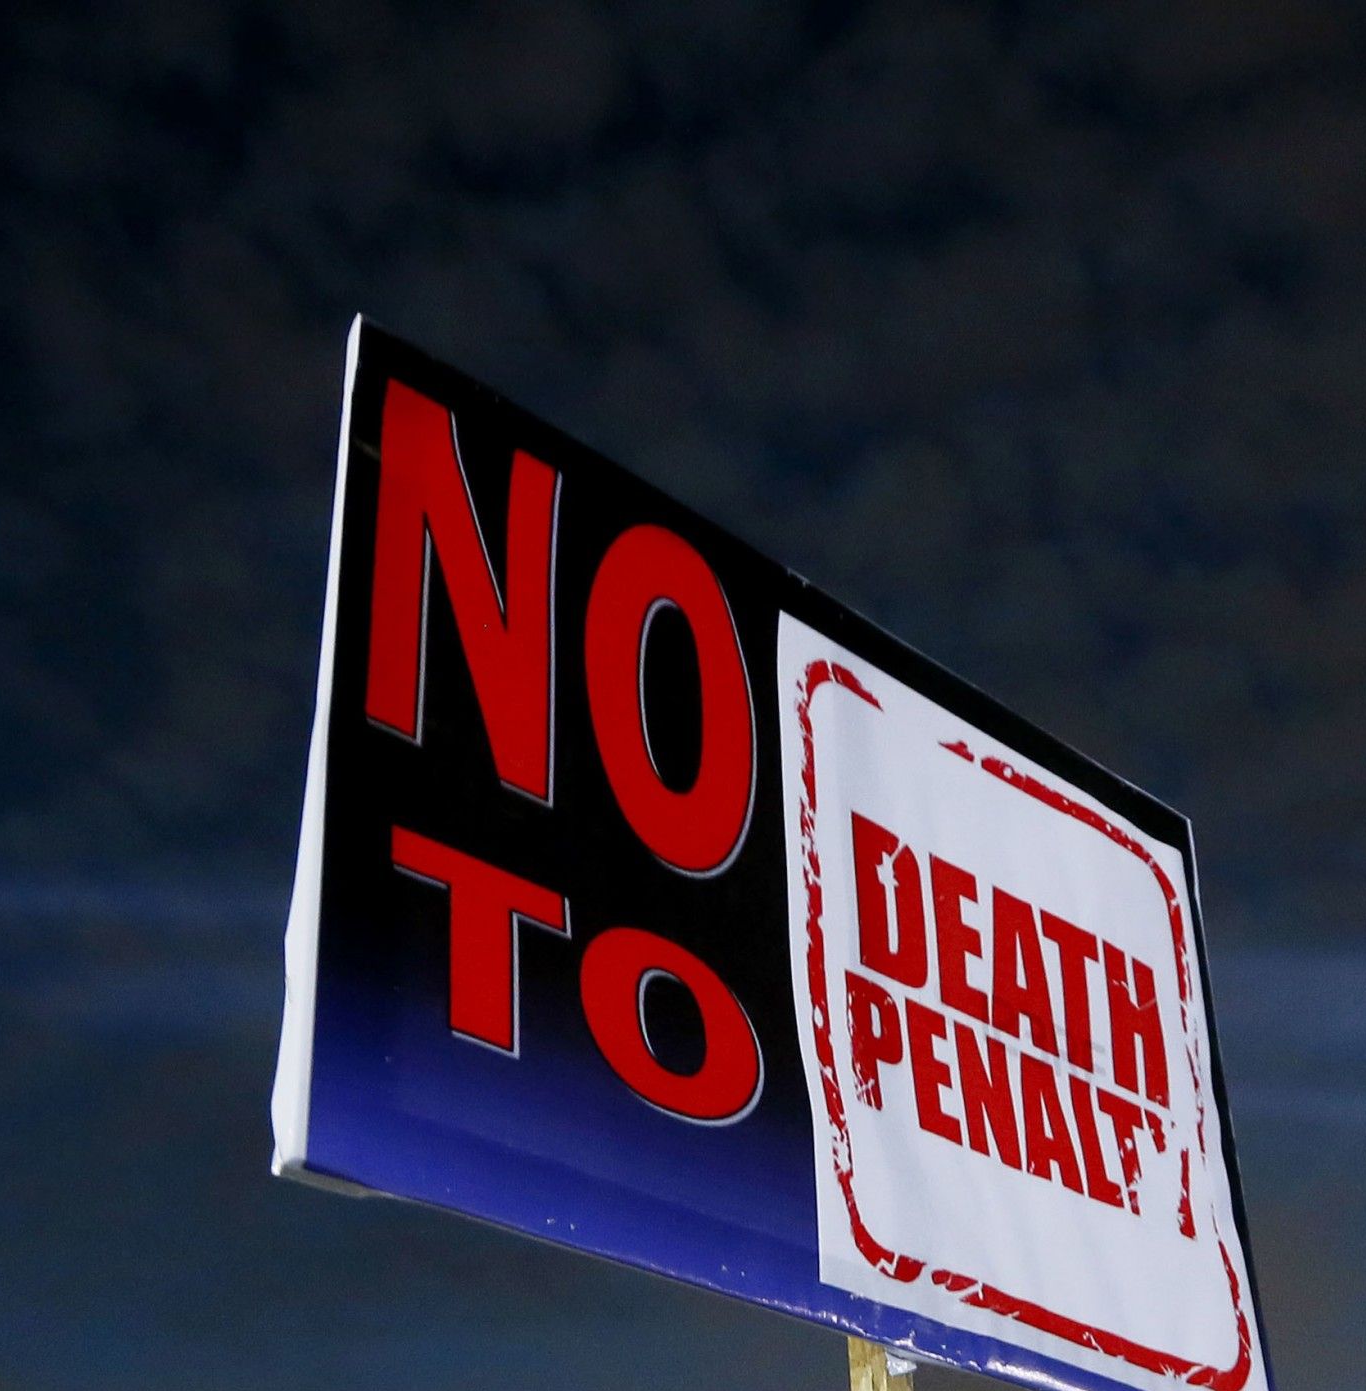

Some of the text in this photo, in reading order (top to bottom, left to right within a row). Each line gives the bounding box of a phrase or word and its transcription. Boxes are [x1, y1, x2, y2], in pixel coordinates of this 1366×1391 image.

[365, 376, 757, 877] NO
[390, 824, 765, 1127] TO
[850, 811, 1171, 1111] DEATH
